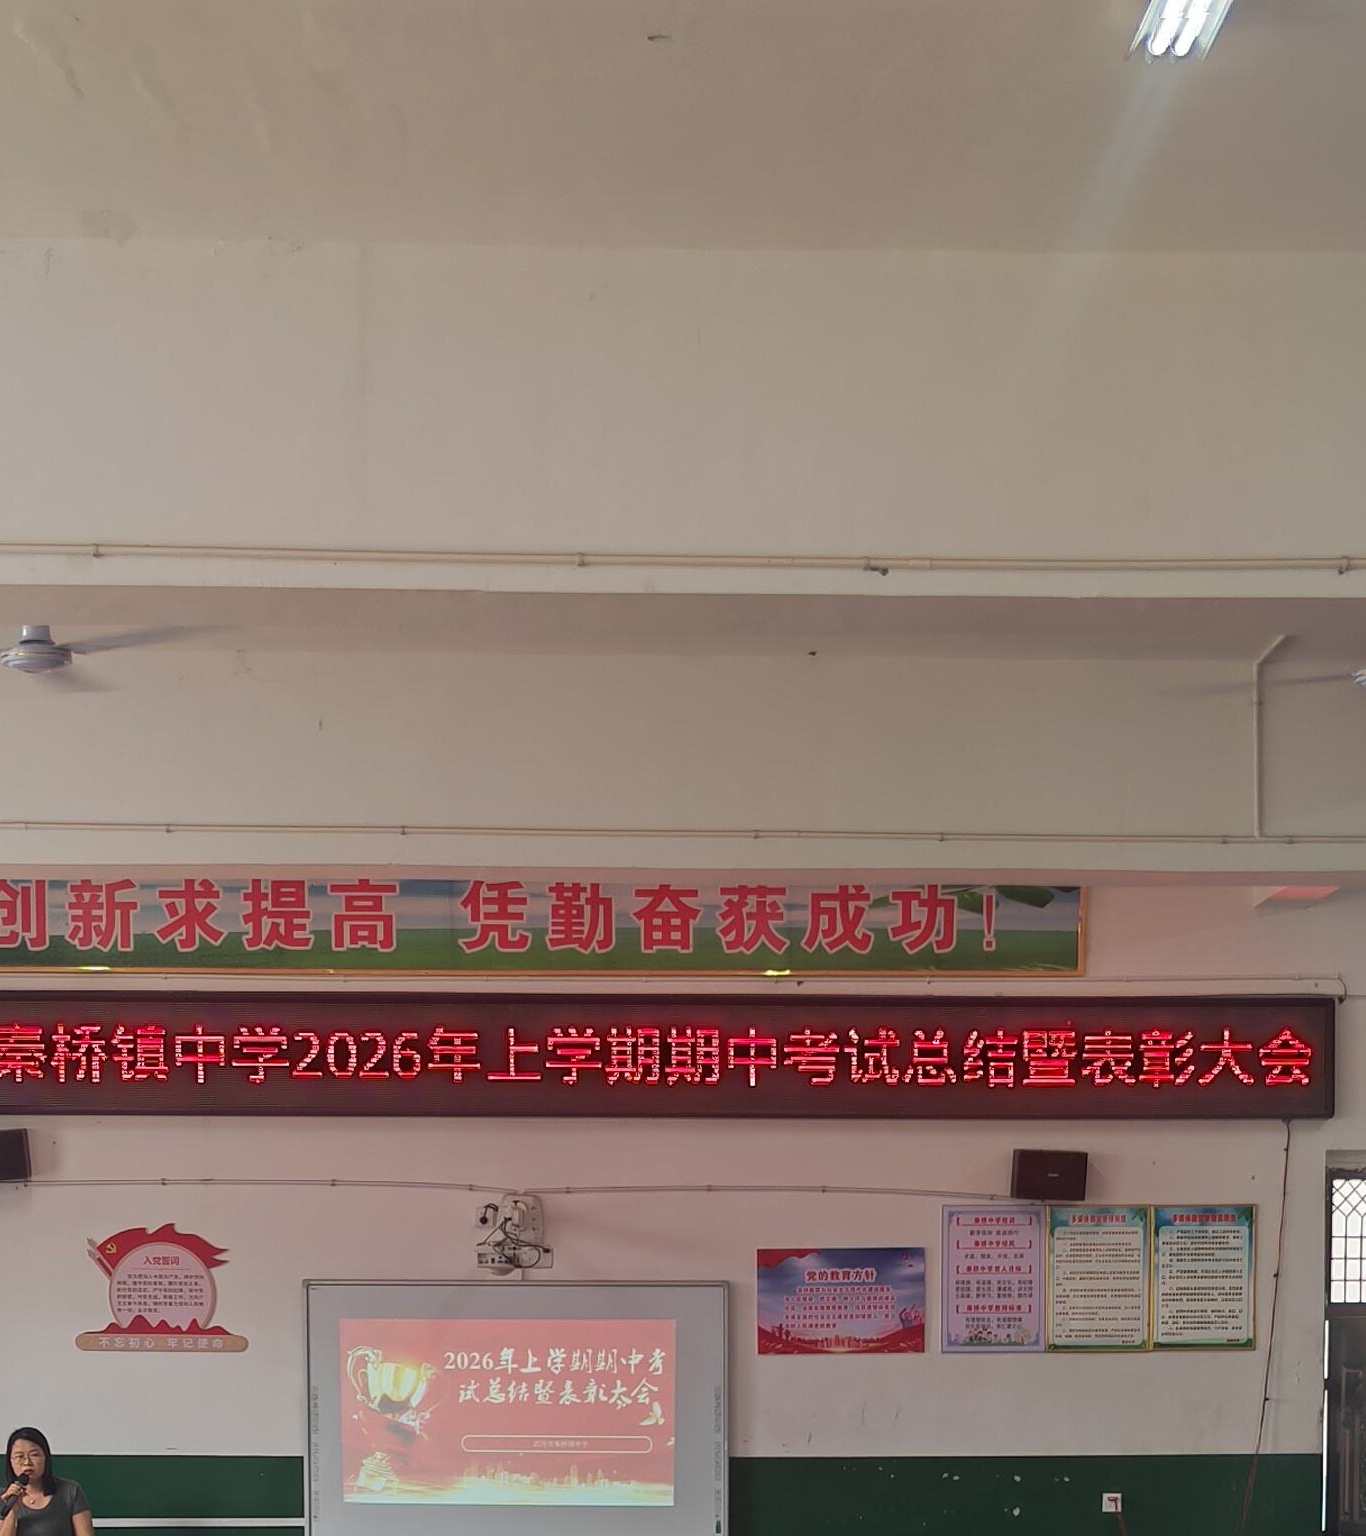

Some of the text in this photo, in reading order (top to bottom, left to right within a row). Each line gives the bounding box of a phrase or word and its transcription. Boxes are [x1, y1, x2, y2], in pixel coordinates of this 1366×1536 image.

[143, 1255, 180, 1266] 入党誓词
[805, 1268, 876, 1282] 党的教育方针
[98, 1336, 226, 1349] 不忘初心 牢记使命
[443, 1346, 667, 1376] 2026年上学期期中考
[458, 1377, 660, 1408] 试总结暨表彰大会
